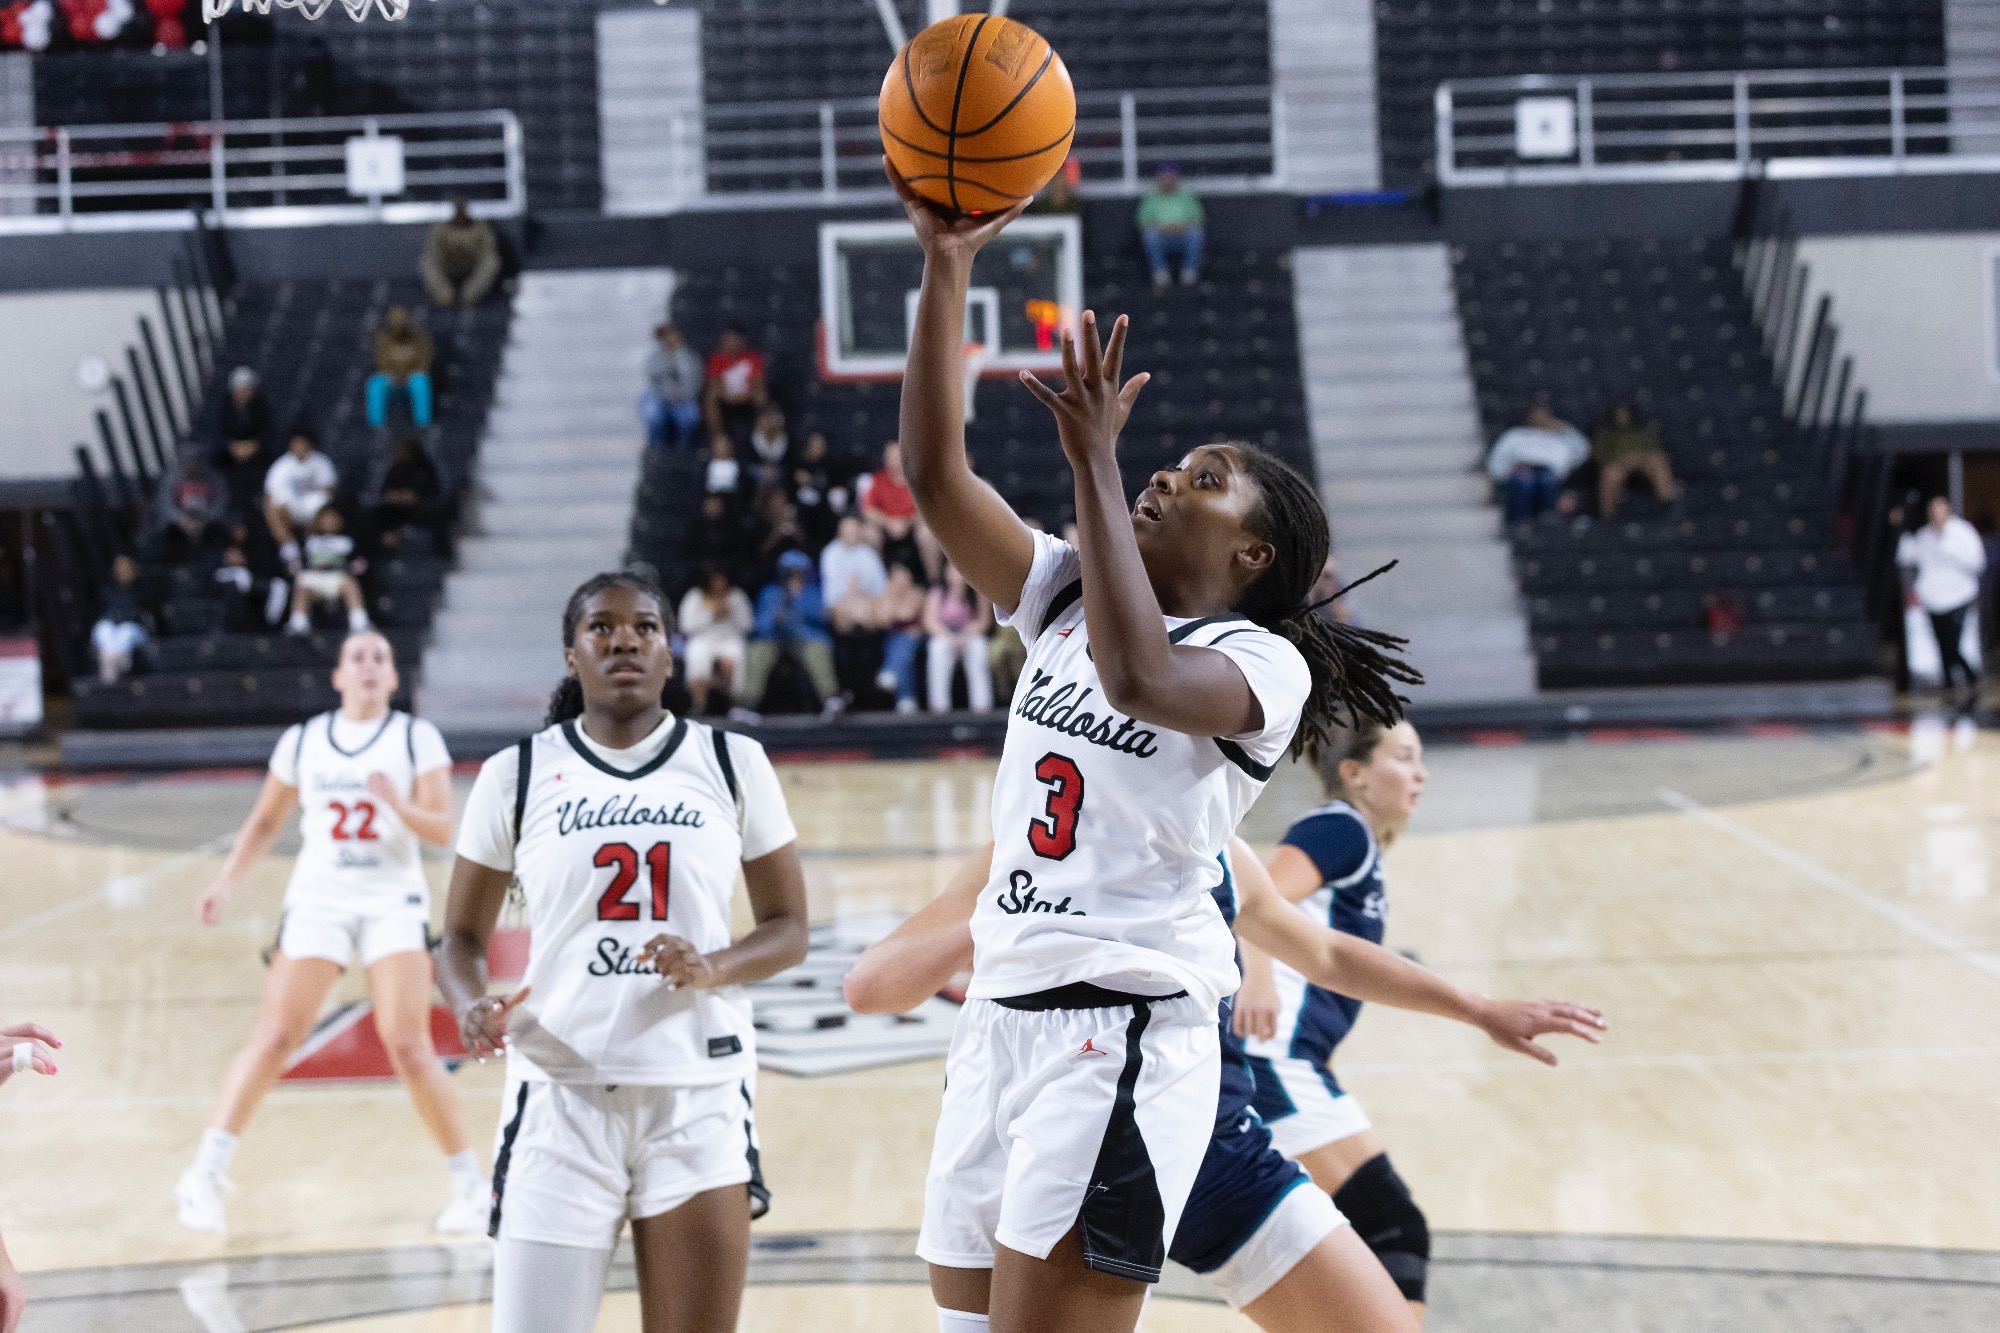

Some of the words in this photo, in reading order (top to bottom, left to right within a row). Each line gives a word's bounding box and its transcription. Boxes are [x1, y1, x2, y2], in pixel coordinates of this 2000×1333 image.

[1015, 667, 1158, 758] Valdosta
[328, 801, 379, 840] 22
[557, 794, 705, 836] Valdosta
[1027, 751, 1085, 861] 3
[593, 842, 671, 921] 21
[997, 869, 1087, 916] Stat
[588, 937, 662, 976] Sta
